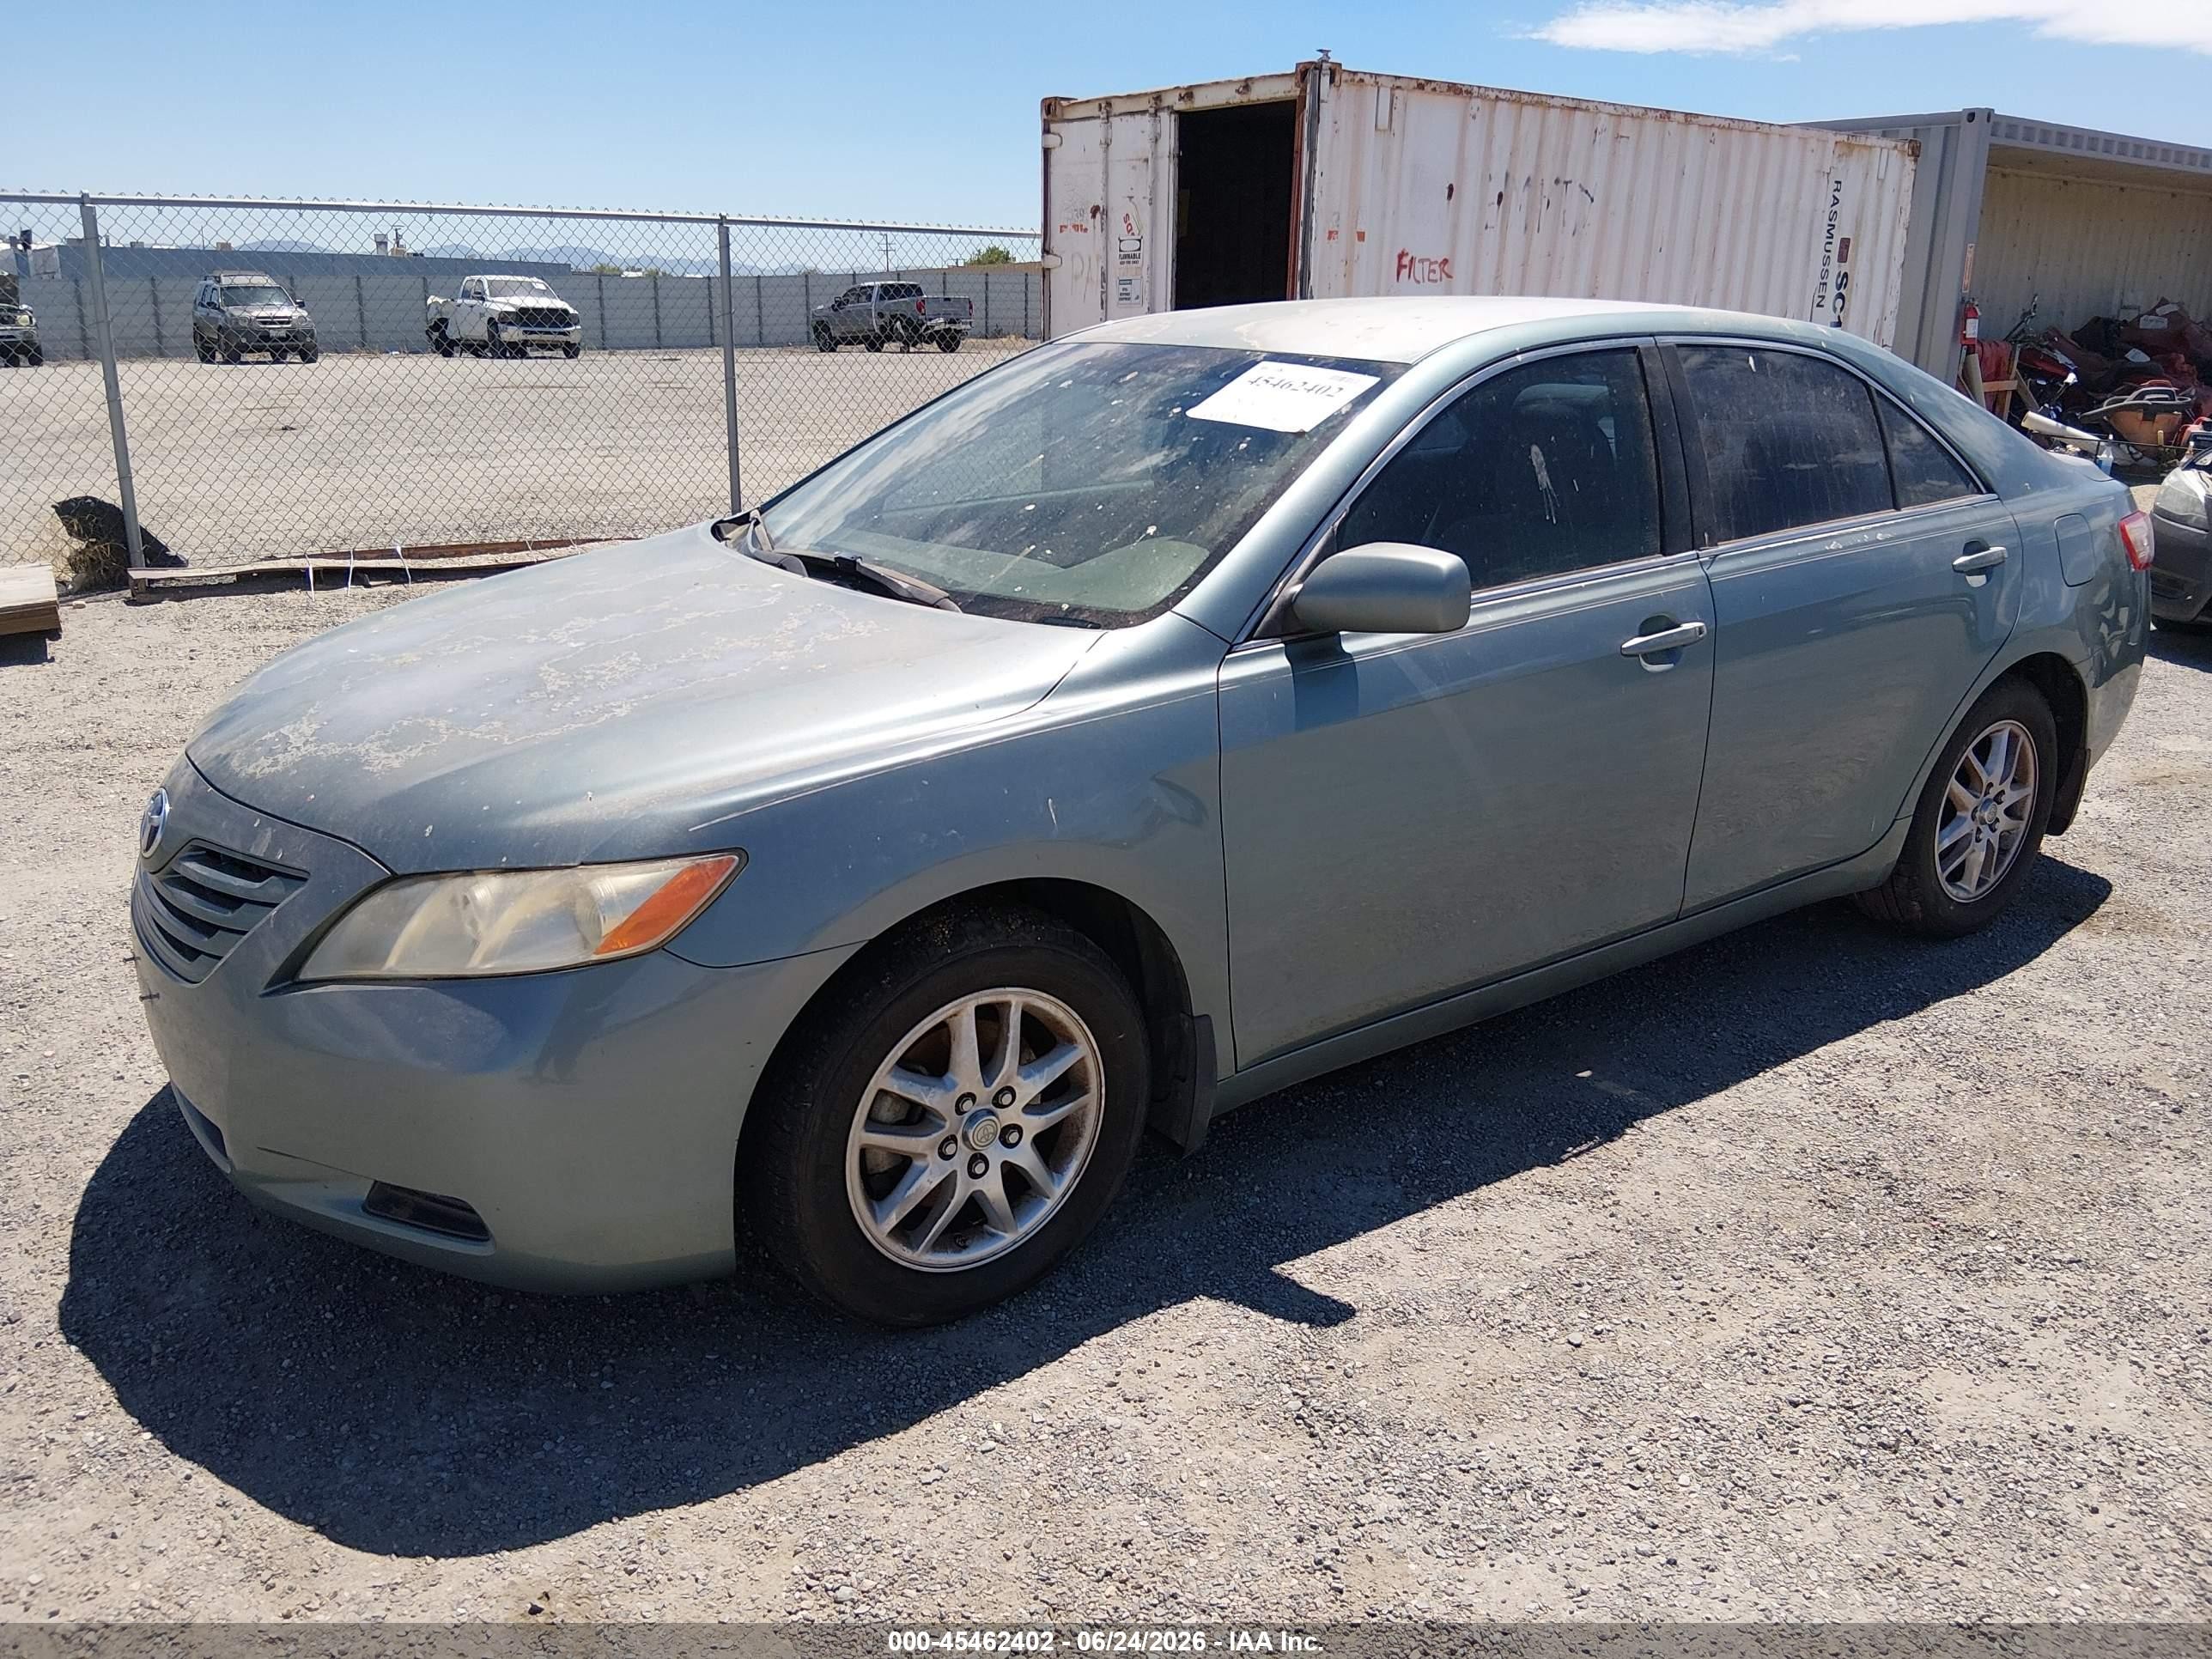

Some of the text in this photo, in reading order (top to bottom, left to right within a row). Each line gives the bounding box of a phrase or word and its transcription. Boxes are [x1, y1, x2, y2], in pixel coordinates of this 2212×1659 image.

[1816, 179, 1843, 308] RASMUSSEN
[1396, 248, 1453, 284] FILTER
[1247, 375, 1345, 398] 45462402
